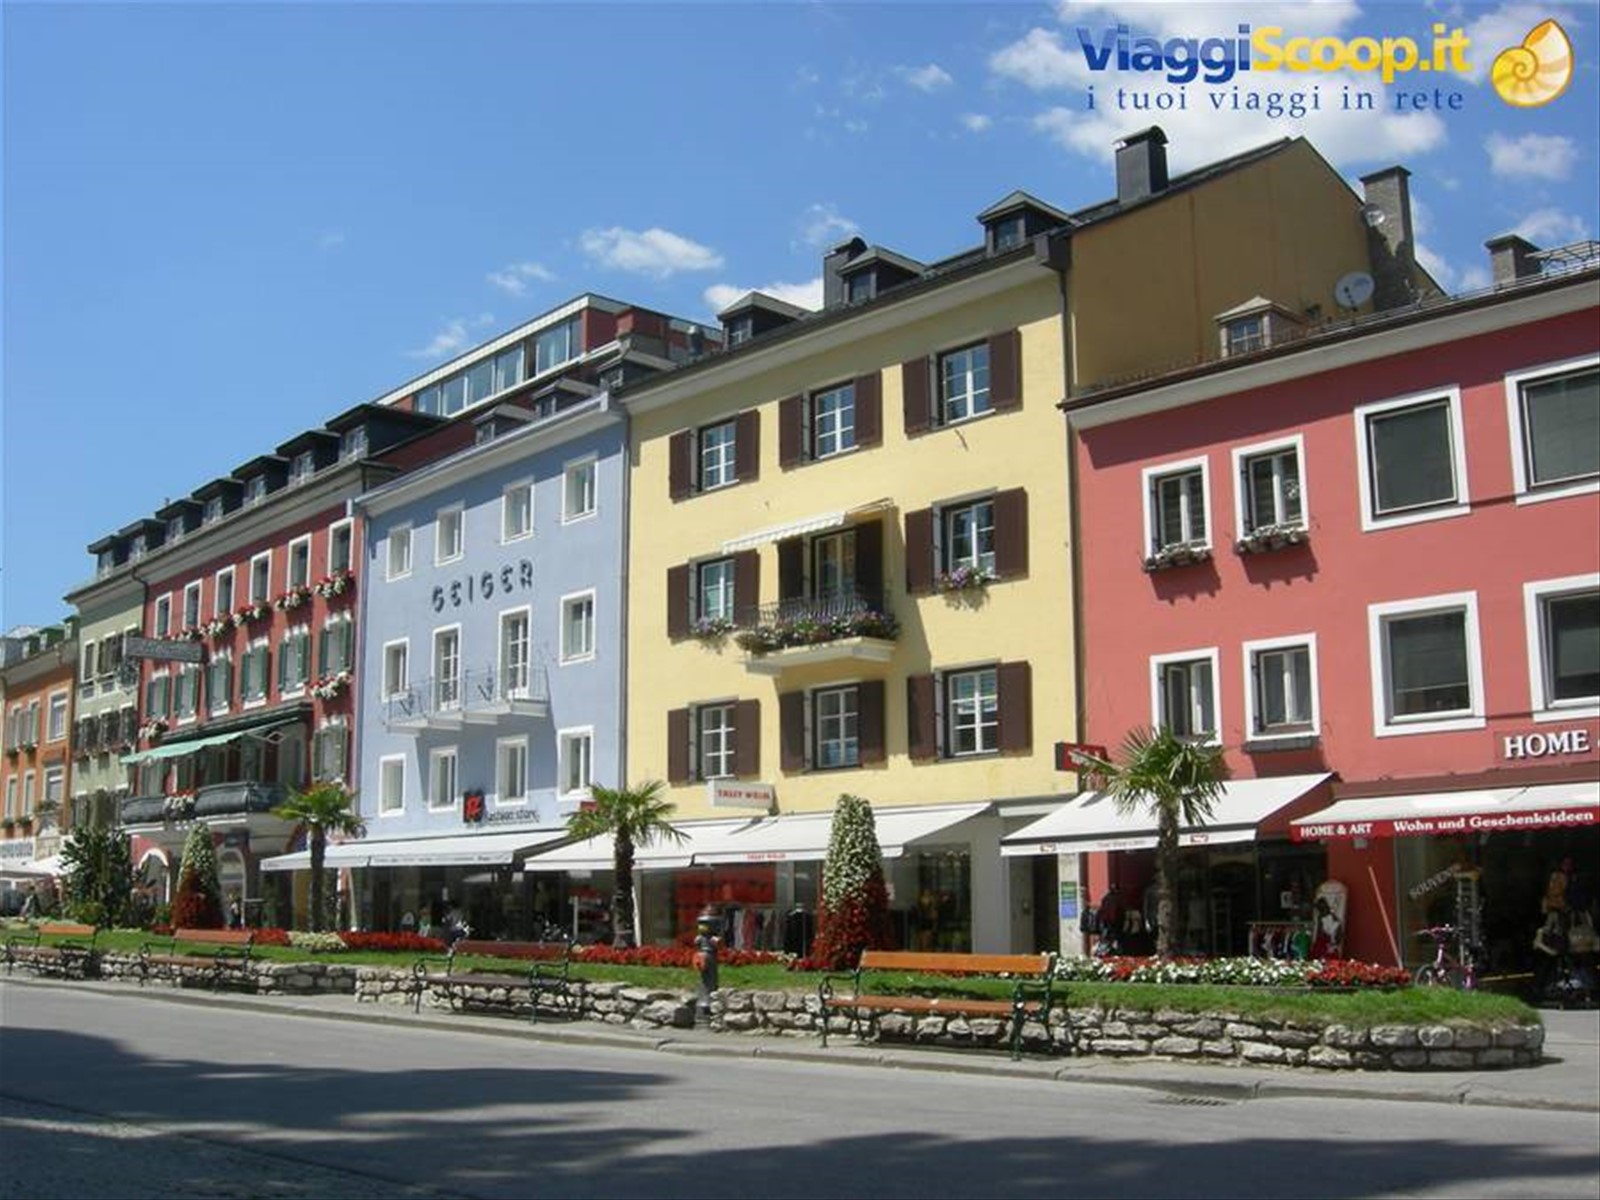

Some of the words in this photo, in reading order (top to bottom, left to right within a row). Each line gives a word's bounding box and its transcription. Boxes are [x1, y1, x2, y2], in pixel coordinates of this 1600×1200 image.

[432, 559, 533, 613] GEIGER
[1504, 729, 1590, 758] HOME
[1300, 825, 1335, 837] HOME
[1336, 824, 1346, 835] &
[1349, 823, 1374, 834] ART
[1393, 820, 1434, 832] Wohn
[1438, 818, 1465, 829] und
[1469, 810, 1594, 829] Geschenksideen
